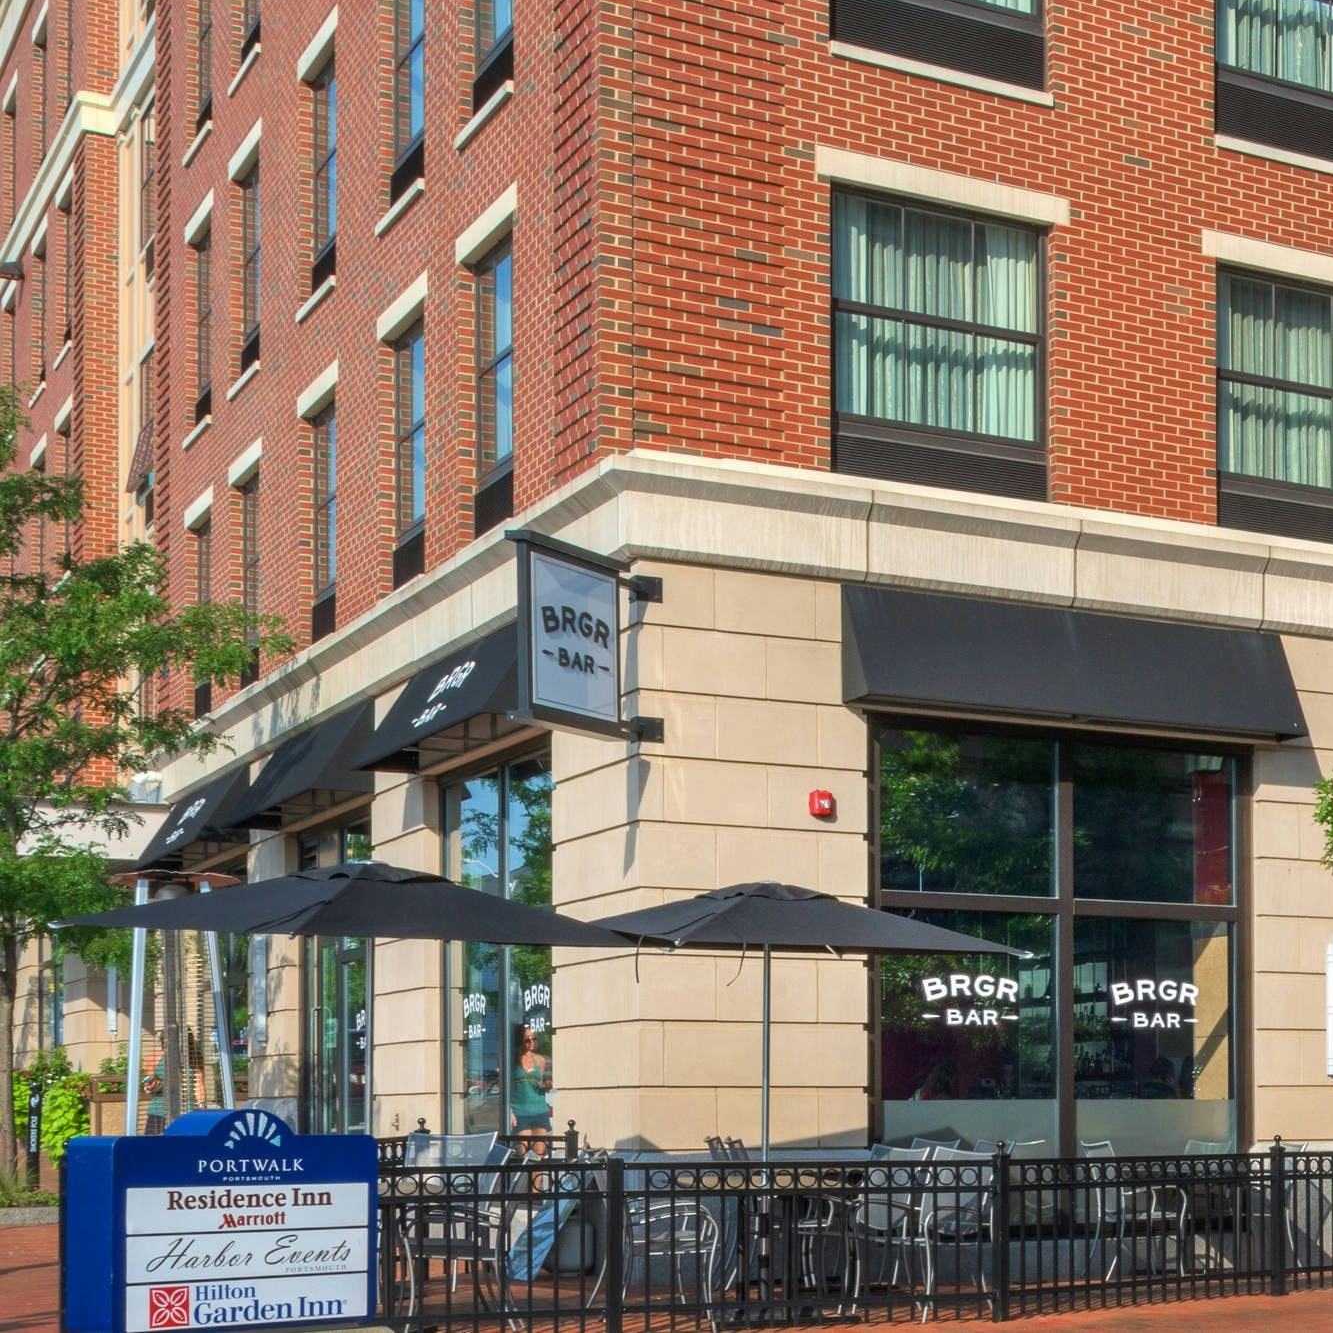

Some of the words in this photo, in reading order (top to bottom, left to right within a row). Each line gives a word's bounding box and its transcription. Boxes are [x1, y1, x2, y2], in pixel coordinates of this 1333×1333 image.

[541, 605, 610, 649] BRGR
[558, 647, 595, 674] BAR
[524, 984, 551, 1012] BRGR
[922, 974, 1019, 1003] BRGR
[1111, 979, 1200, 1006] BRGR
[463, 993, 487, 1019] BRGR
[946, 1009, 999, 1027] BAR
[468, 1024, 482, 1039] BAR
[530, 1018, 545, 1034] BAR
[1133, 1012, 1181, 1028] BAR
[198, 1157, 305, 1174] PORTWALK
[167, 1189, 287, 1211] Residence
[291, 1187, 333, 1207] Inn
[218, 1211, 286, 1230] Marriott
[146, 1237, 253, 1274] Harbor
[264, 1234, 352, 1266] Events
[195, 1285, 256, 1301] Hilton
[193, 1301, 293, 1325] Garden
